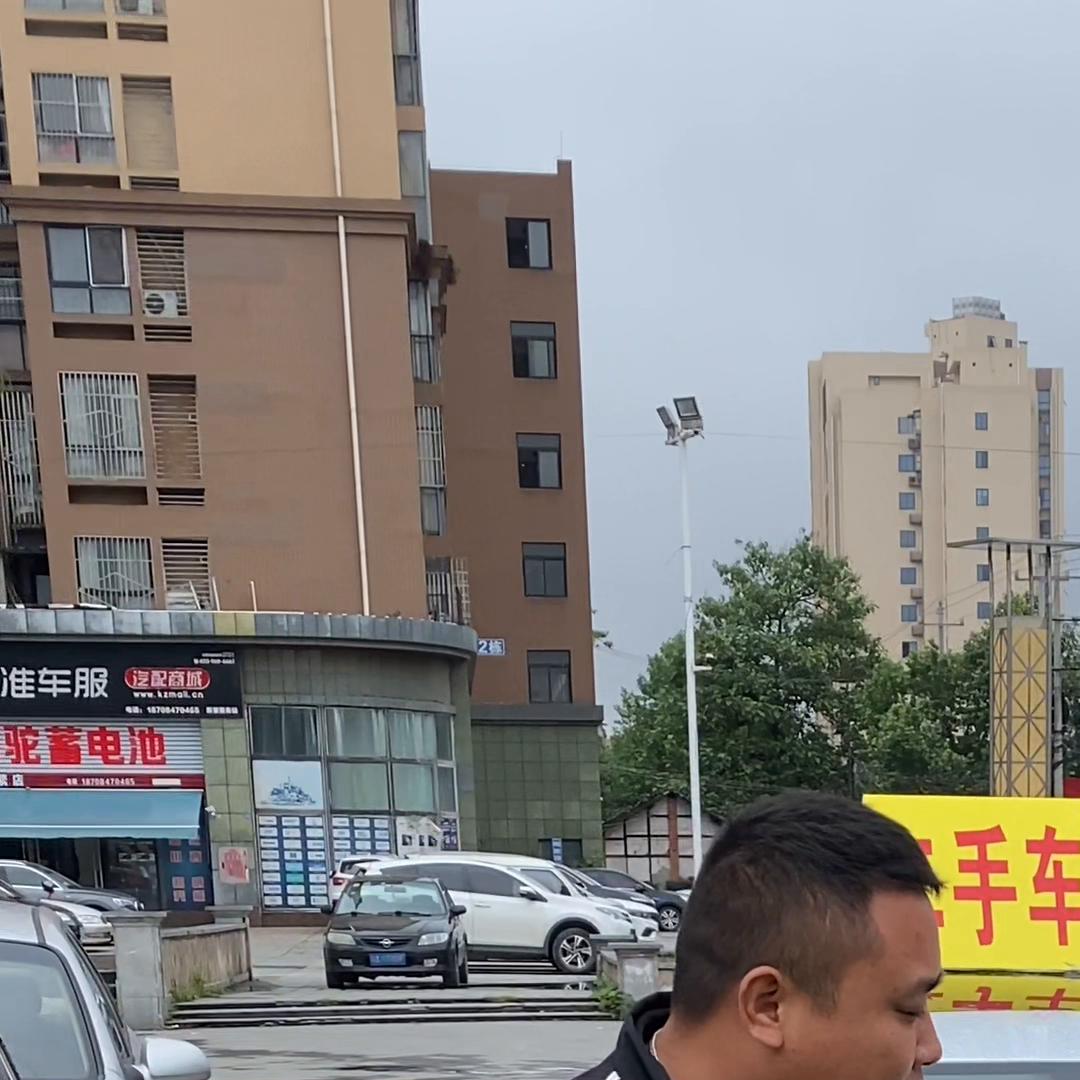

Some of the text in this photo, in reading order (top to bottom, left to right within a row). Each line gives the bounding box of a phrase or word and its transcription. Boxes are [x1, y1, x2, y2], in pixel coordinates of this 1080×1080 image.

[0, 666, 109, 698] 准车服
[2, 725, 167, 765] 驼蓄电池
